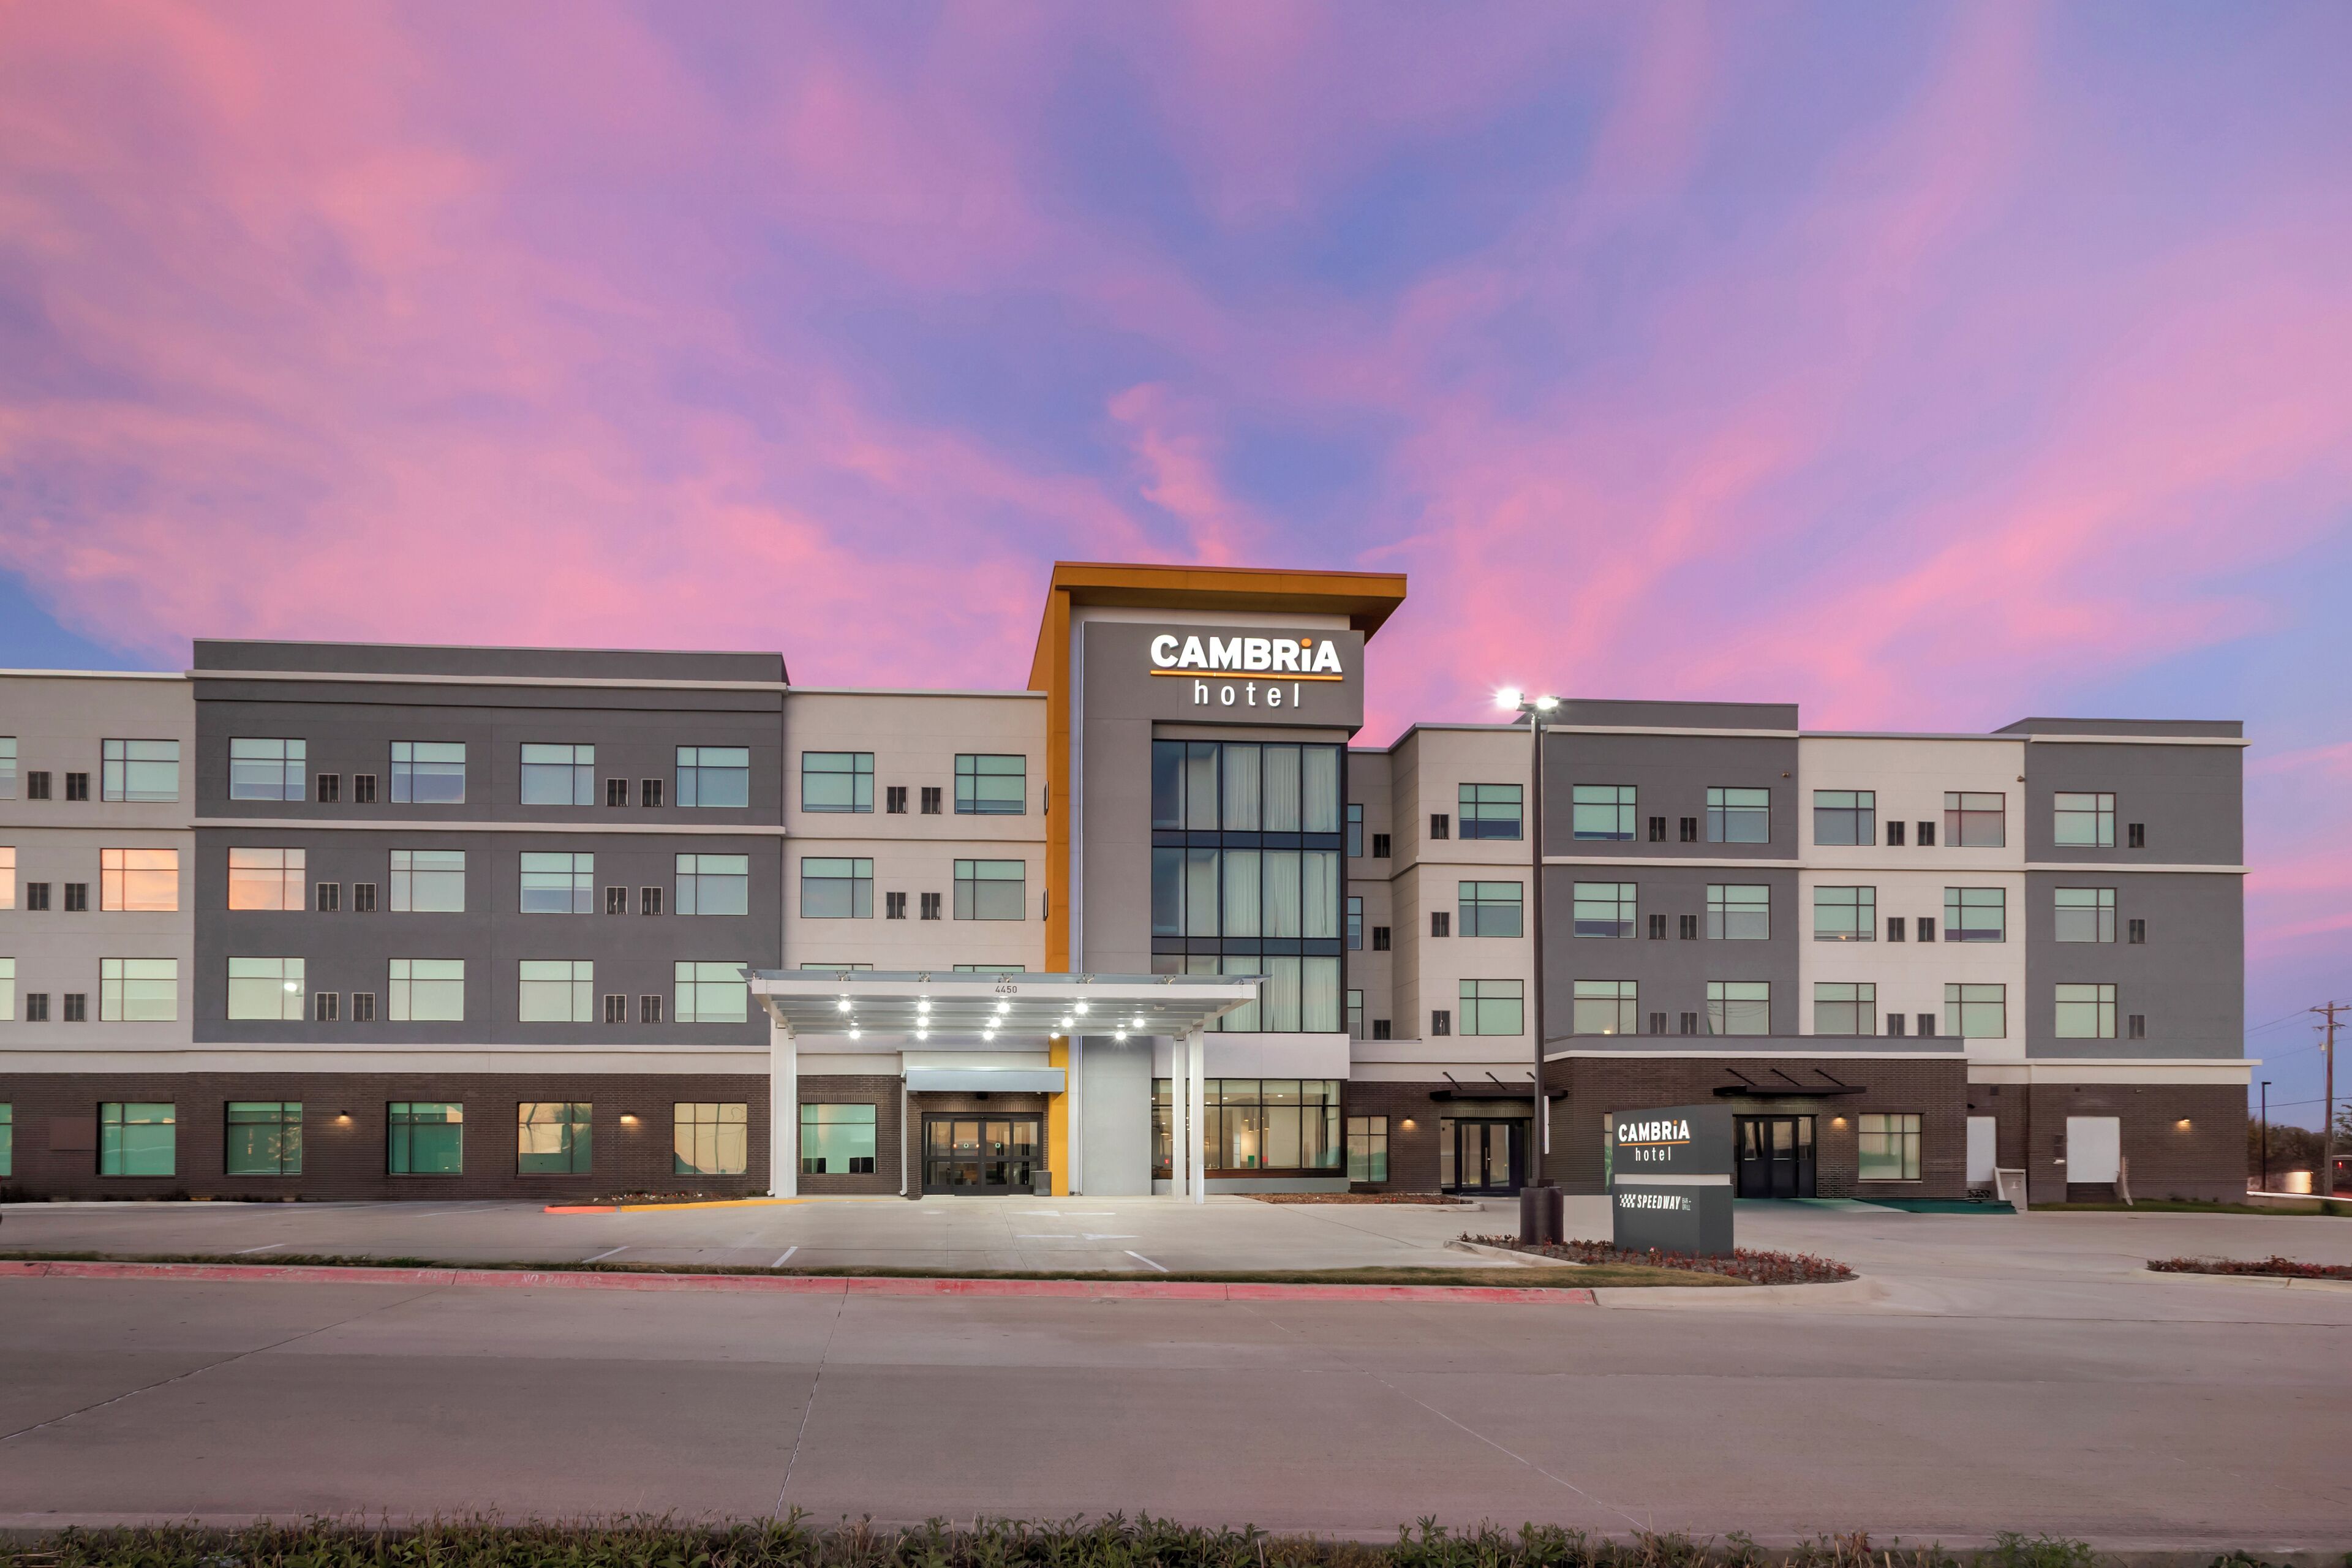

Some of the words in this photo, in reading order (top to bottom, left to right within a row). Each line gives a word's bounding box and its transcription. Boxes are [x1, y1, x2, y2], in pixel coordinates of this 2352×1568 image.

[1194, 679, 1299, 707] hotel
[1635, 1146, 1671, 1161] hotel
[1637, 1194, 1681, 1210] SPEEDWAY
[521, 1274, 540, 1283] NO
